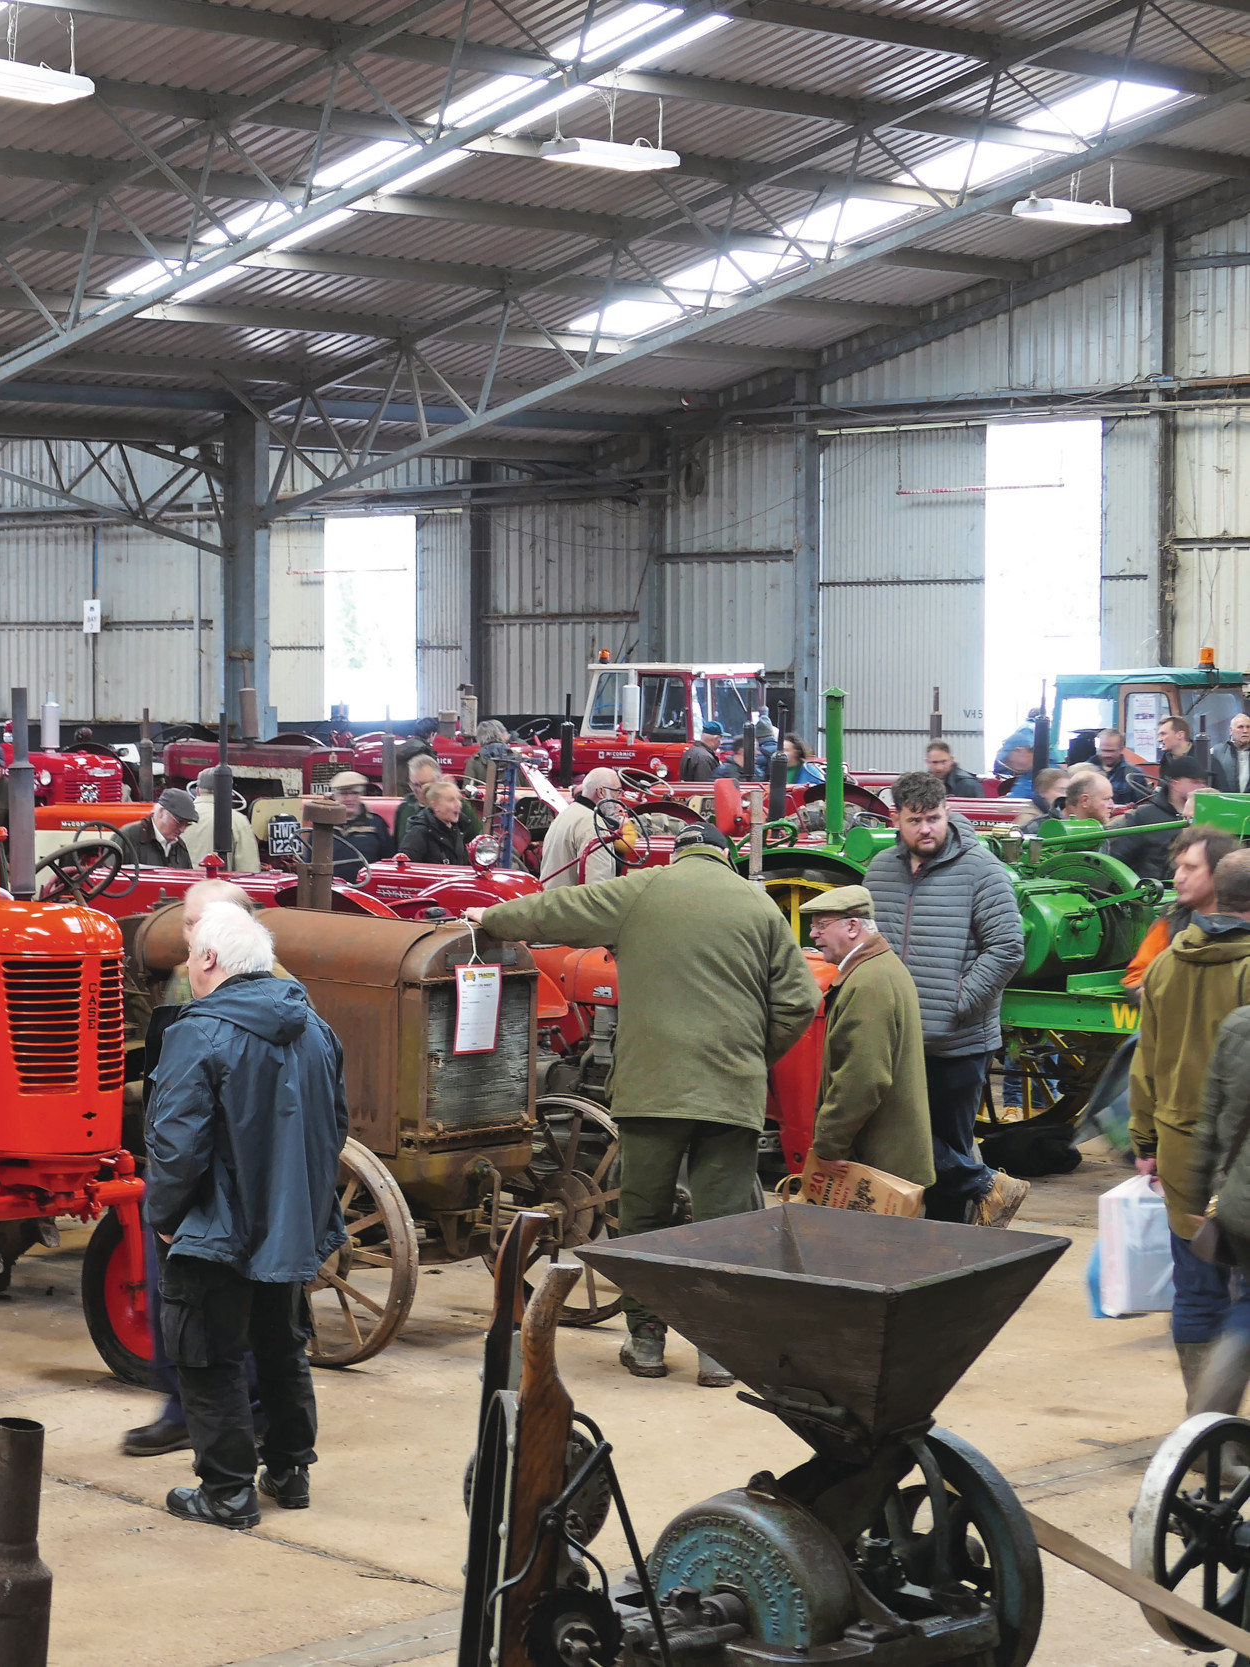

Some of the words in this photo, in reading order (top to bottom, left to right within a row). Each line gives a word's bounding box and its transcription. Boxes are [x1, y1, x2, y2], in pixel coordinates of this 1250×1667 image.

[87, 982, 98, 1029] CASE
[810, 1172, 825, 1195] 20
[821, 1176, 835, 1206] mpany
[680, 1550, 712, 1586] INGTON
